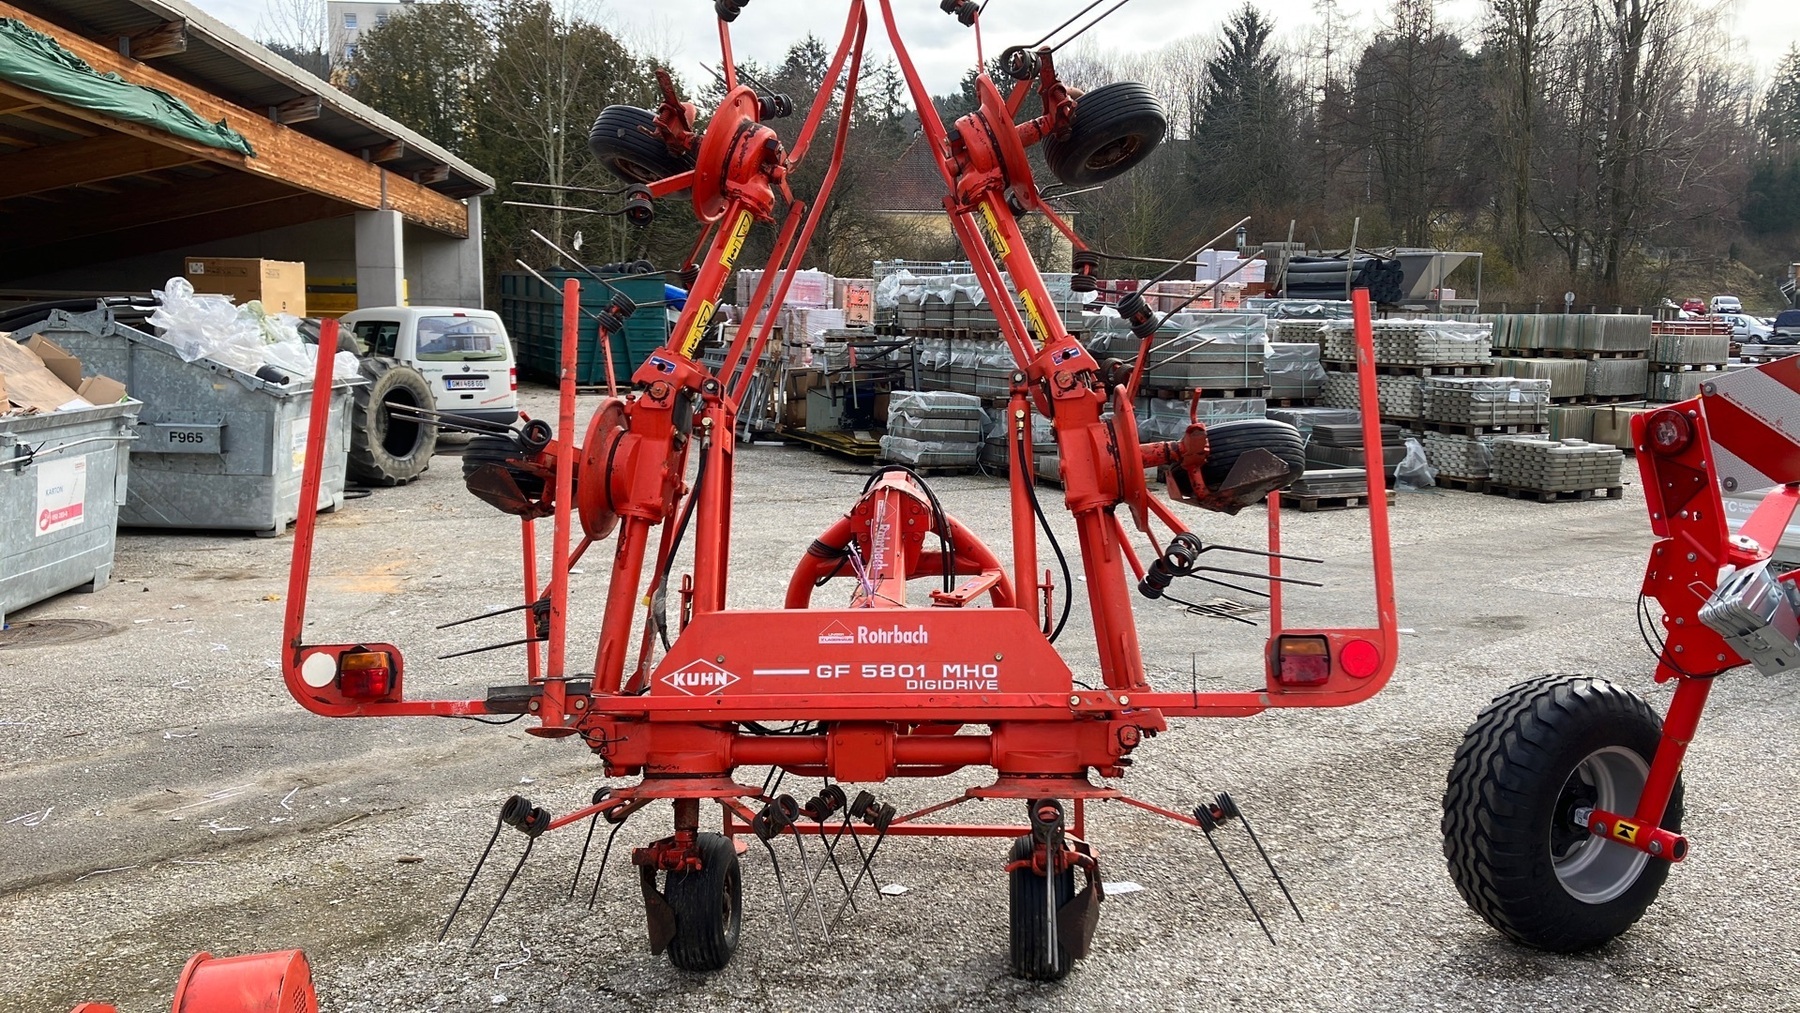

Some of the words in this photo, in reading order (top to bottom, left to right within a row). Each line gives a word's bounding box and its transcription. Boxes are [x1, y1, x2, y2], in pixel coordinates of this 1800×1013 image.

[169, 431, 203, 443] F965
[45, 486, 64, 496] KARTON
[857, 624, 928, 644] Rohrbach
[816, 664, 850, 678] GF
[861, 664, 926, 678] 5801
[942, 664, 998, 678] MHO
[673, 672, 728, 686] KUHN
[906, 679, 998, 690] DIGIDRIVE
